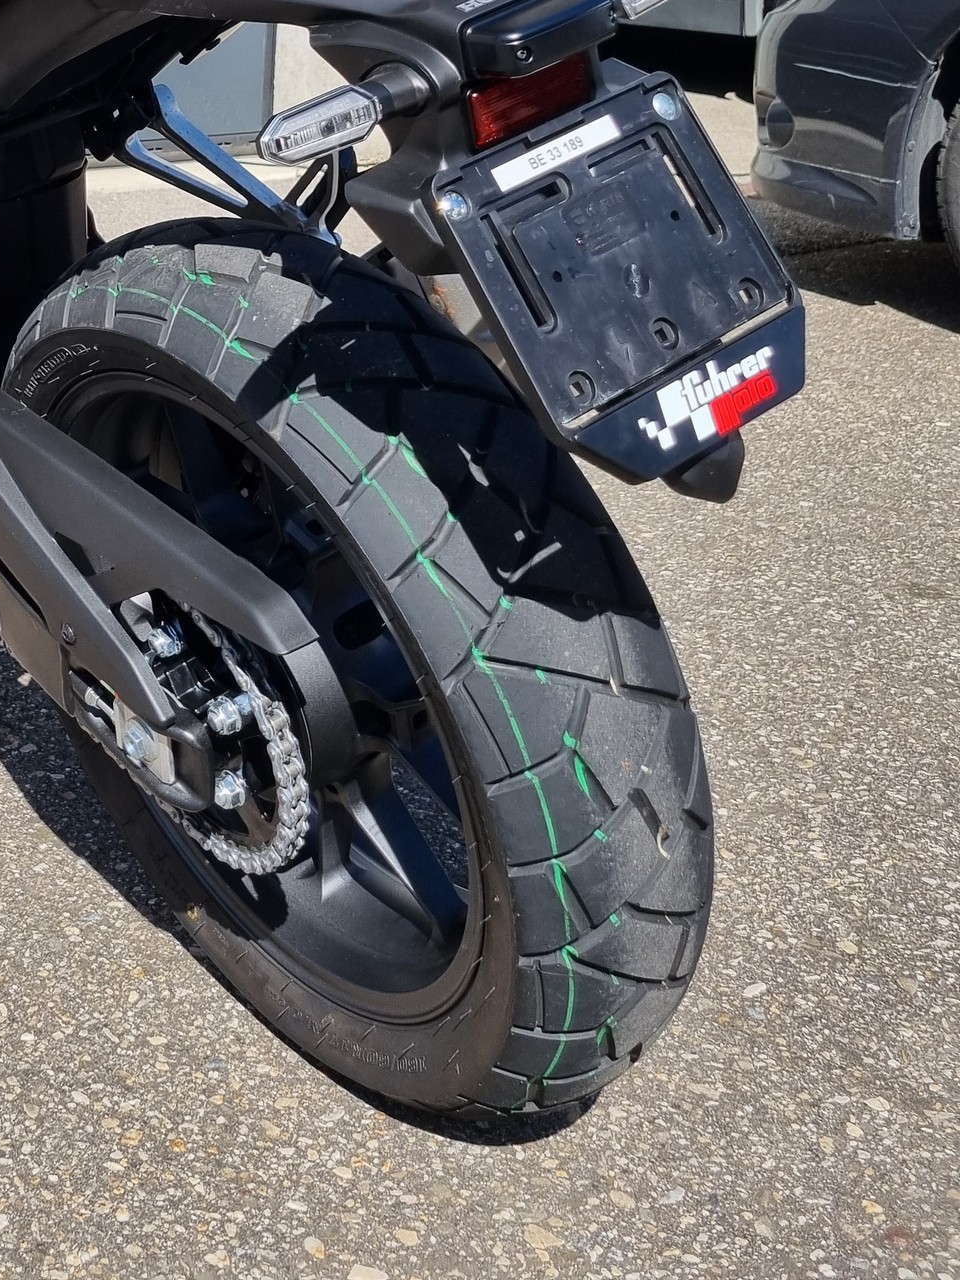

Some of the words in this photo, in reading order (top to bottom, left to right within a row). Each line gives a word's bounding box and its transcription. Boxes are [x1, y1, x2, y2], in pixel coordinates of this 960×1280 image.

[528, 153, 546, 170] BE
[546, 146, 562, 161] 33
[563, 135, 584, 154] 189
